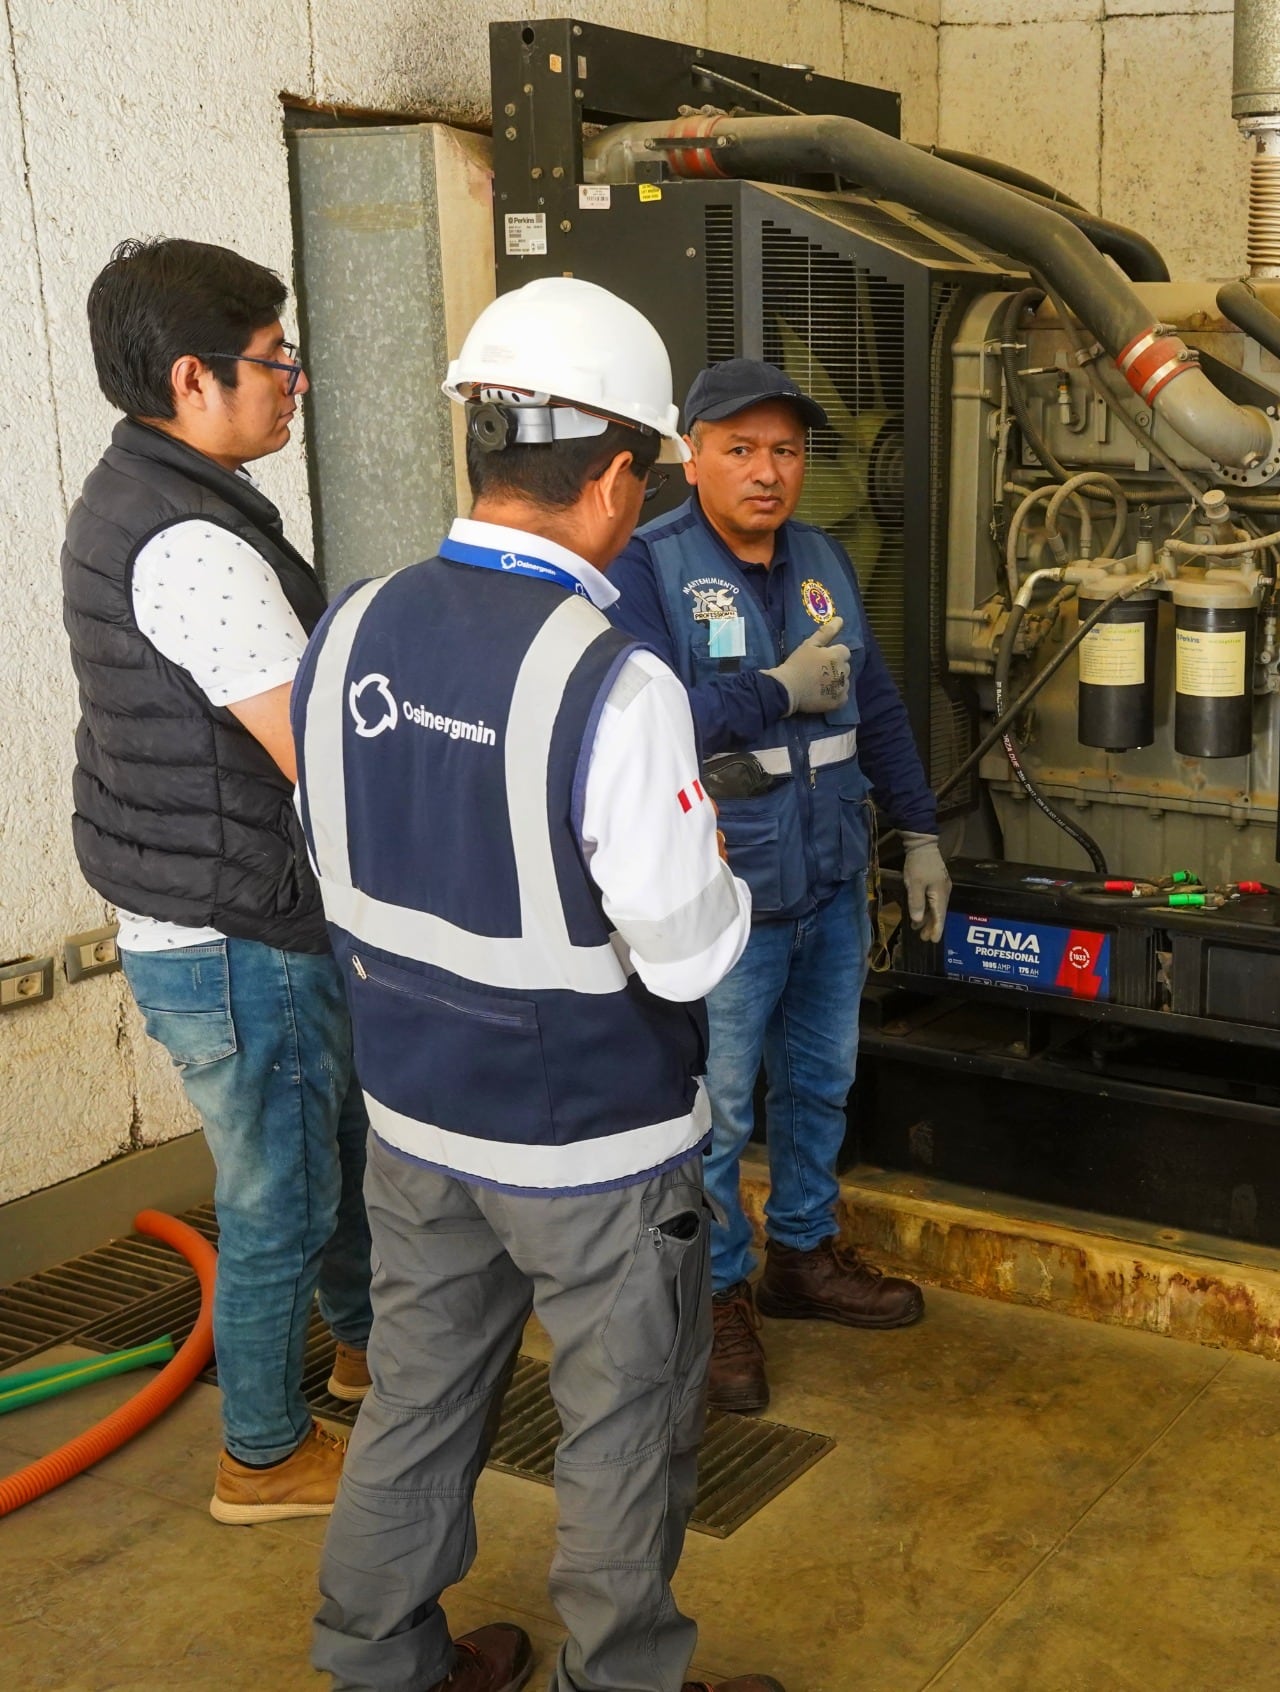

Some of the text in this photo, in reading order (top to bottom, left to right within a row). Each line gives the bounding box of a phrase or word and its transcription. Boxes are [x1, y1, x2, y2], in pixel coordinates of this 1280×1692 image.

[402, 700, 496, 747] Osinergmin
[966, 925, 1041, 953] ETNA
[975, 946, 1040, 964] PROFESIONAL
[997, 963, 1011, 971] AMP
